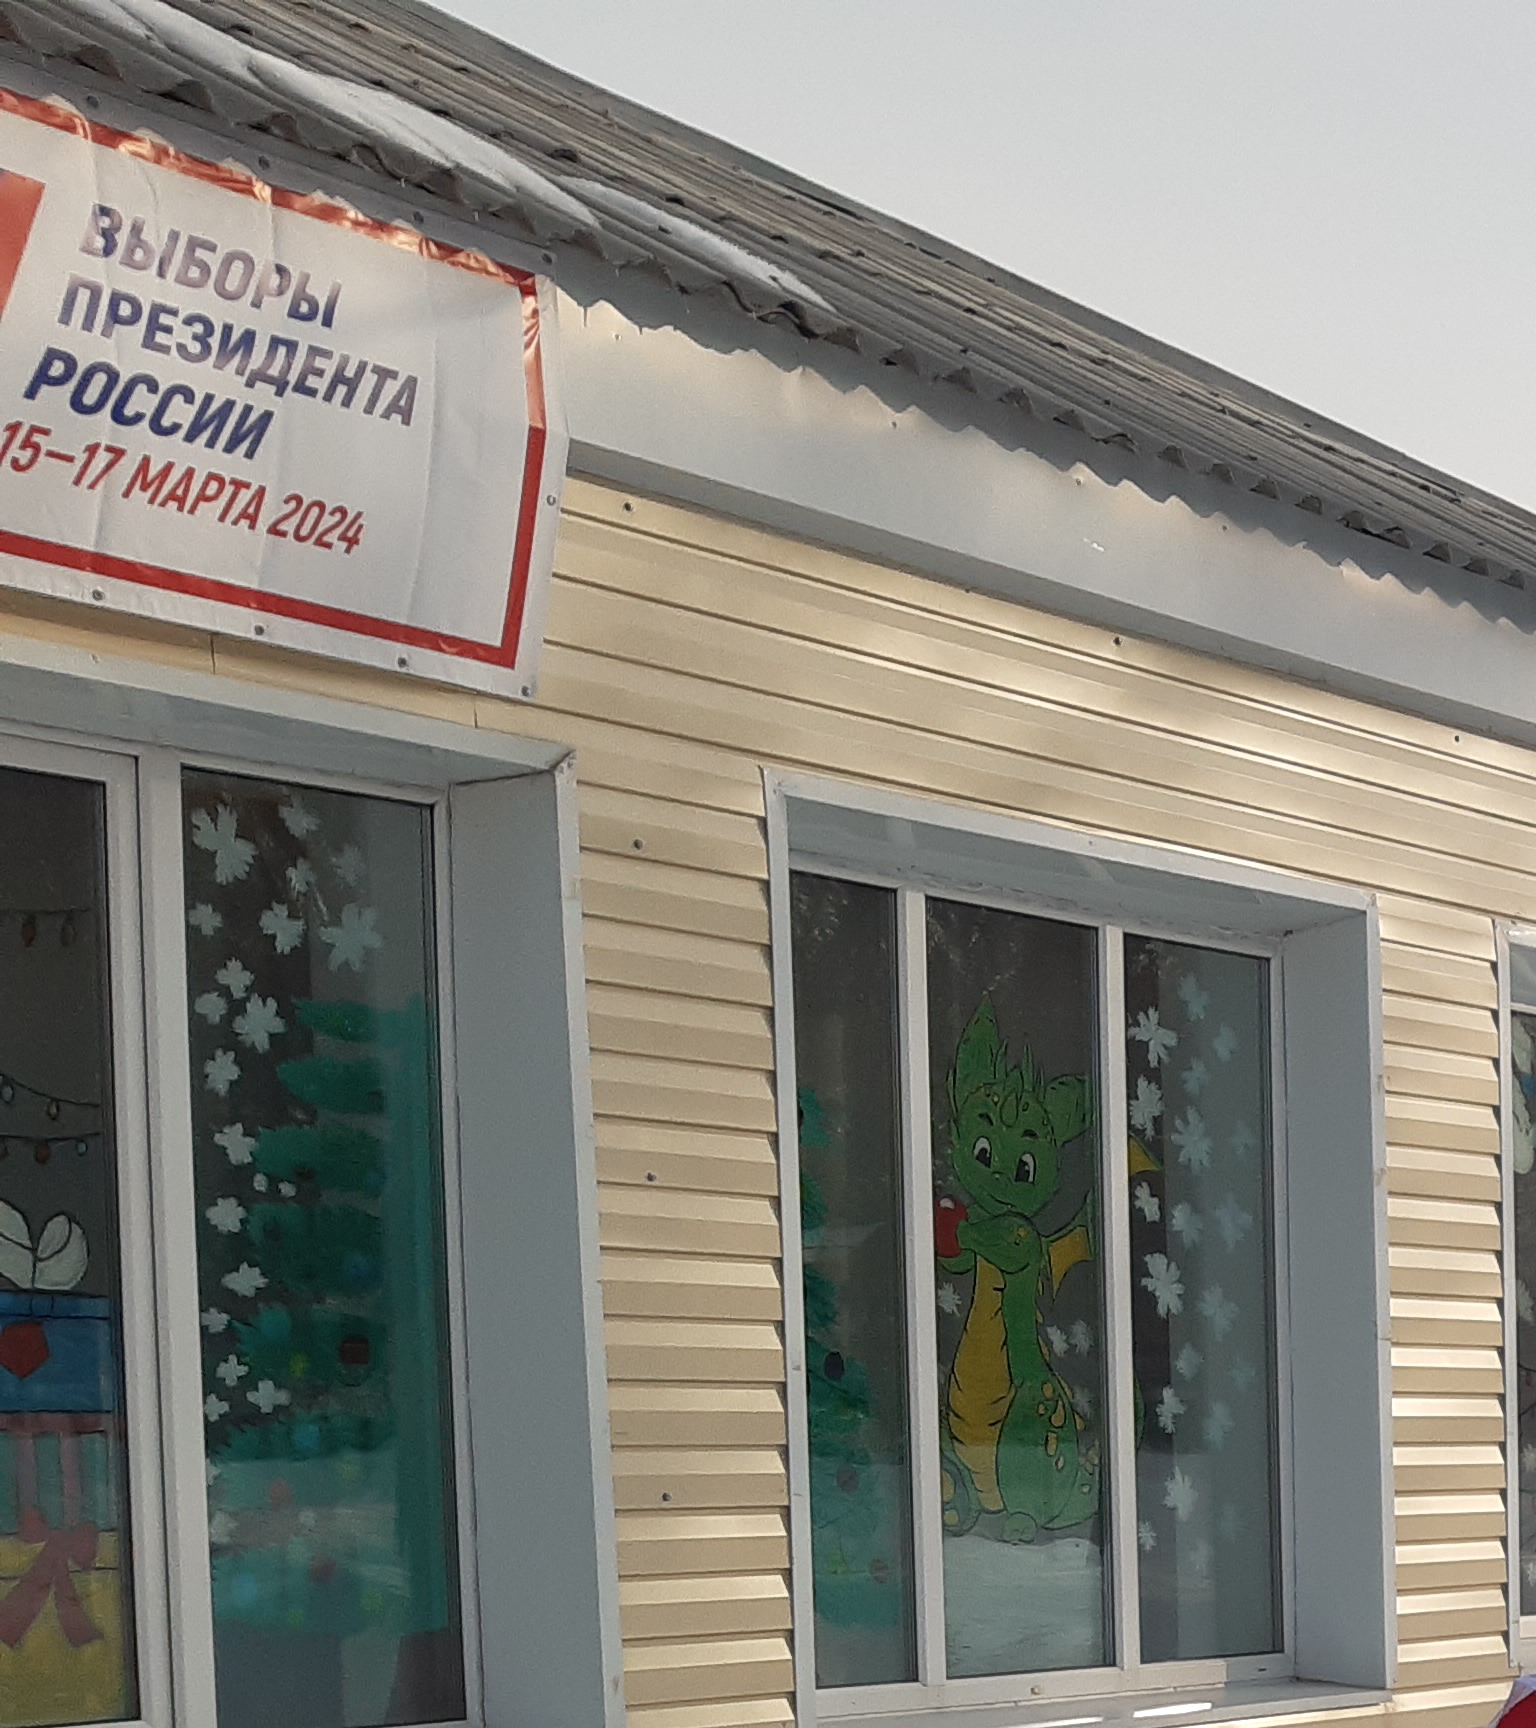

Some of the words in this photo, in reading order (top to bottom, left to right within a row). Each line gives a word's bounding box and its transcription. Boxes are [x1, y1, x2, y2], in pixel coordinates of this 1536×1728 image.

[79, 203, 342, 328] ВЫБОРЫ
[23, 347, 274, 460] РОССИИ
[57, 272, 419, 427] ПРЕЗИДЕНТА
[122, 454, 267, 531] МАРТА
[267, 493, 365, 555] 2024
